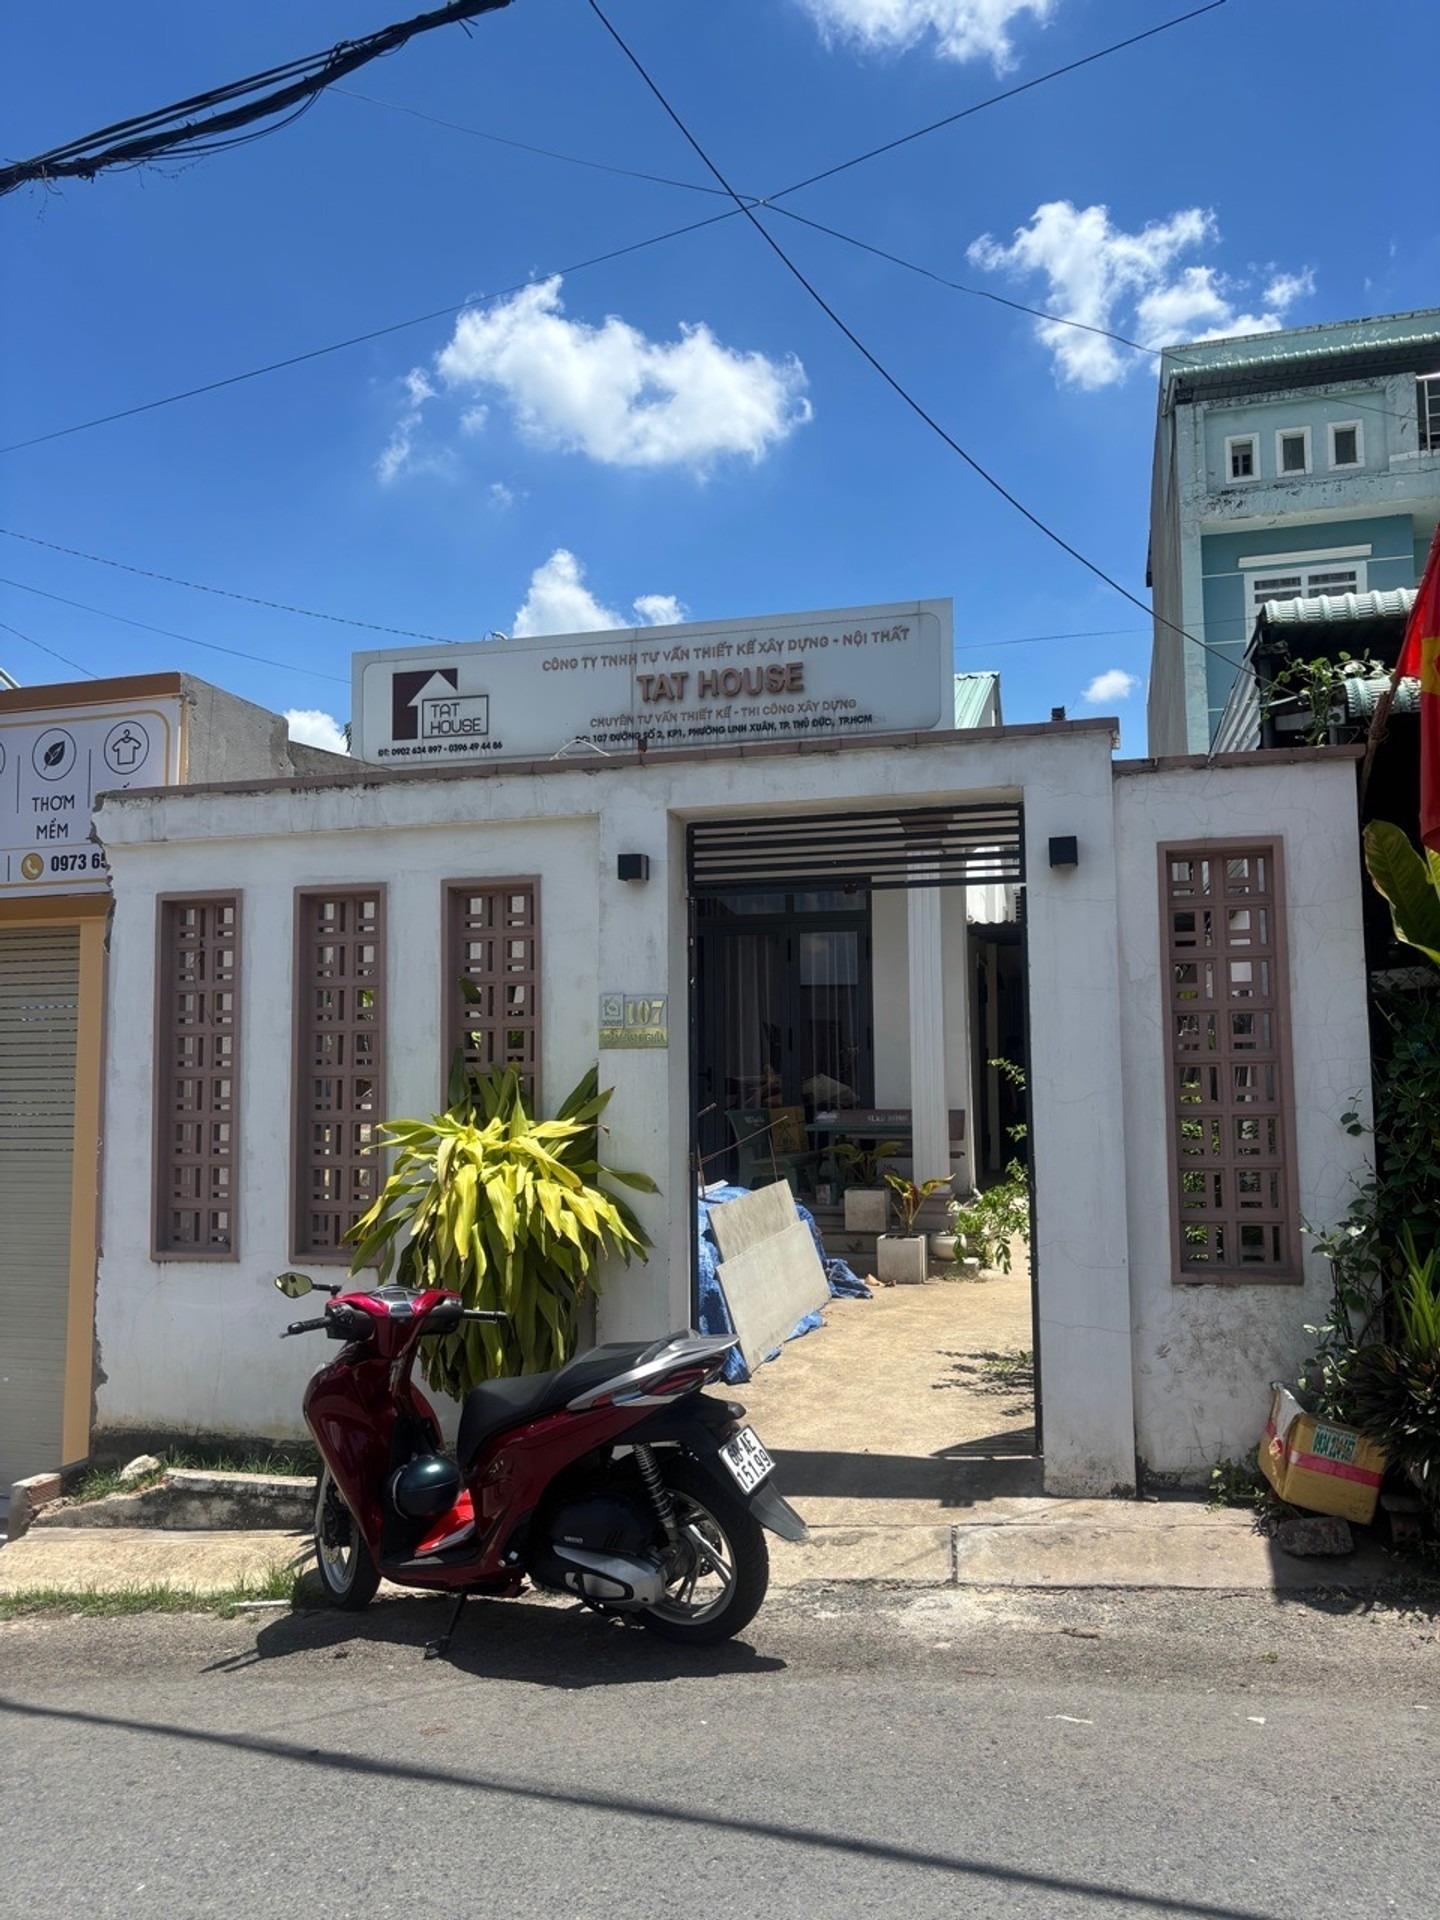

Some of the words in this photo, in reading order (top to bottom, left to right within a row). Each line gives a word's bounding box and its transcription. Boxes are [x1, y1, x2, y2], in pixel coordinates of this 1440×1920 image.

[542, 656, 578, 671] CÔNG
[581, 656, 597, 670] TY
[600, 653, 637, 668] TNHH
[641, 651, 660, 663] TƯ
[663, 645, 690, 662] VẤN
[693, 640, 734, 659] THIẾT
[736, 639, 757, 655] KẾ
[758, 638, 785, 654] XÂY
[788, 634, 829, 652] DỰNG
[842, 630, 868, 647] NỘI
[871, 625, 910, 643] THẤT
[636, 671, 690, 703] TAT
[698, 661, 804, 699] HOUSE
[430, 702, 461, 718] TAT
[590, 713, 634, 728] CHUYÊN
[637, 711, 653, 725] TƯ
[655, 709, 678, 723] VẤN
[680, 707, 713, 721] THIẾT
[716, 705, 733, 719] KẾ
[742, 704, 760, 716] THI
[763, 701, 795, 716] CÔNG
[797, 700, 820, 713] XÂY
[822, 698, 857, 712] DỰNG
[430, 717, 482, 734] HOUSE
[593, 733, 608, 743] 107
[688, 725, 725, 737] PHƯỜNG
[727, 723, 747, 734] LINH
[793, 716, 810, 729] THỦ
[839, 714, 873, 725] TP.HCM
[32, 795, 75, 812] THƠM
[51, 854, 87, 872] 0973
[625, 1000, 664, 1025] 107
